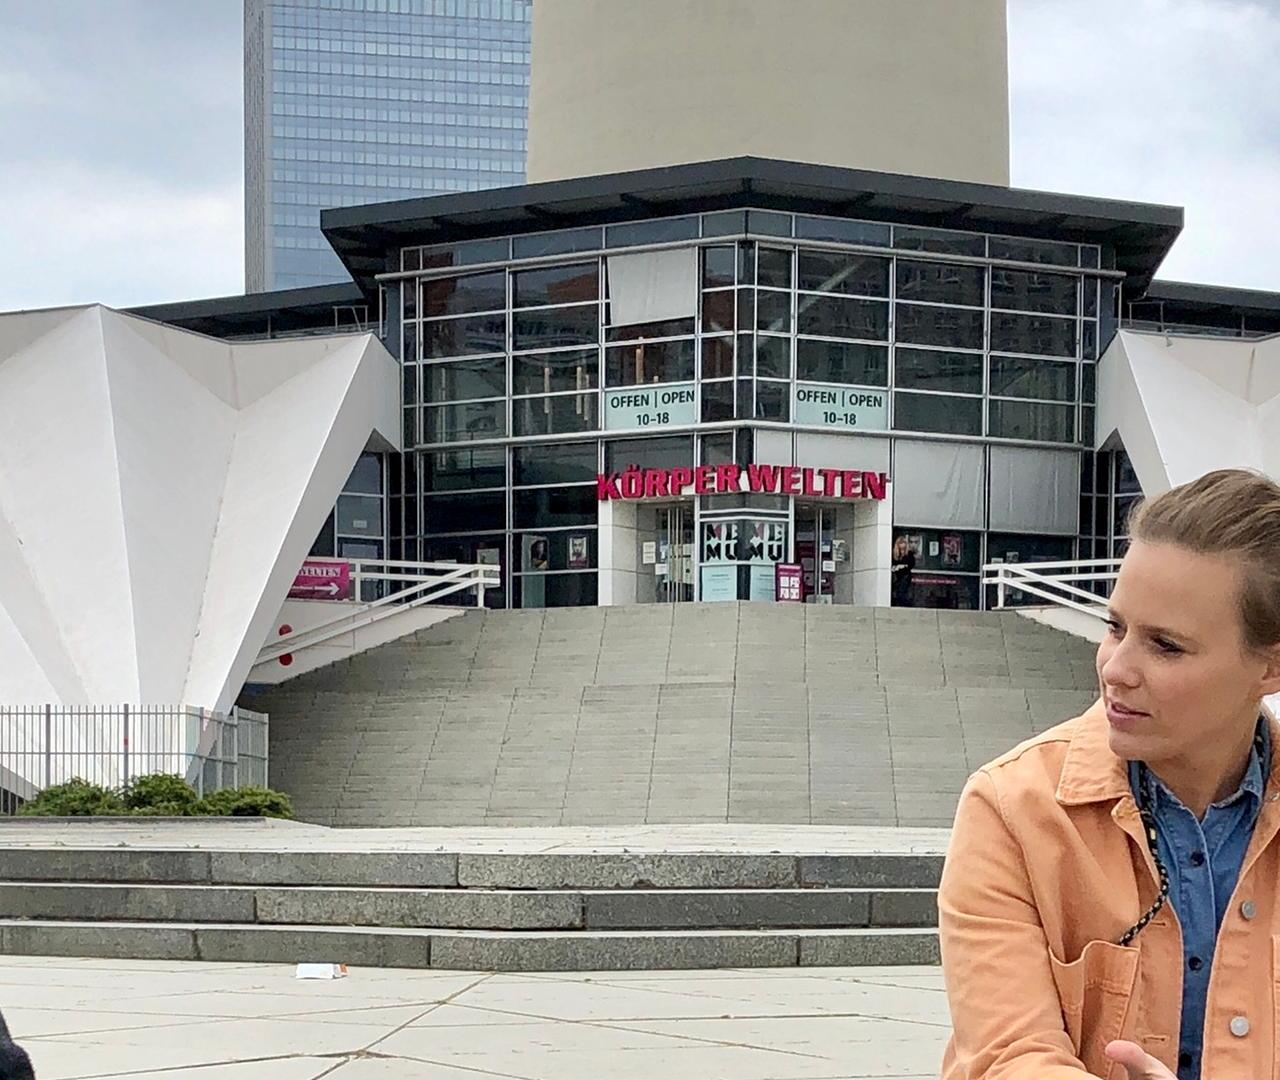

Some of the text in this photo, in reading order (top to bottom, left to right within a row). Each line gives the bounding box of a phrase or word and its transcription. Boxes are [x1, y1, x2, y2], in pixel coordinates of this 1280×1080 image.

[611, 390, 695, 409] OFFEN OPEN
[797, 389, 882, 408] OFFEN OPEN
[596, 463, 889, 501] KÖRPER WELTEN
